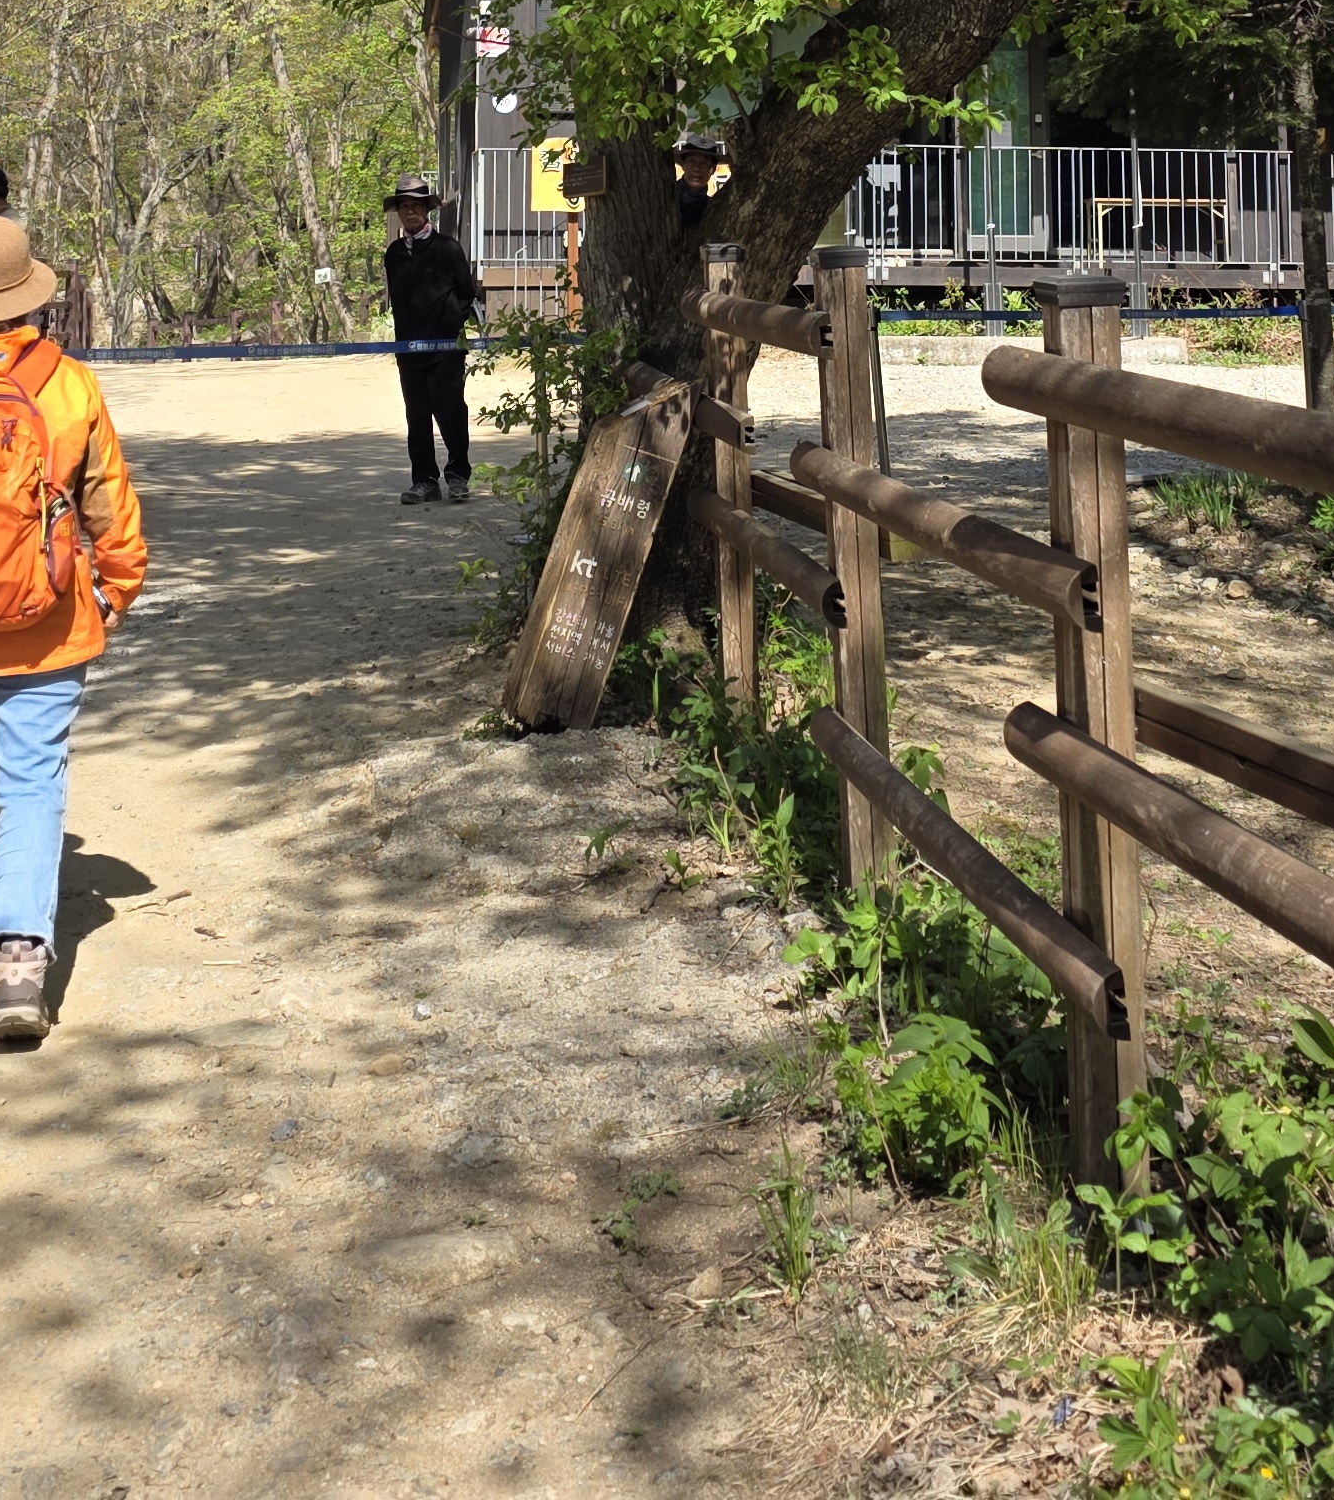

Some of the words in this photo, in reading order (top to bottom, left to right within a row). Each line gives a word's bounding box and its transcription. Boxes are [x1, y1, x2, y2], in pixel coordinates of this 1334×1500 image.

[600, 489, 651, 520] 곰배령
[569, 549, 598, 579] kt
[545, 640, 576, 661] 서비스
